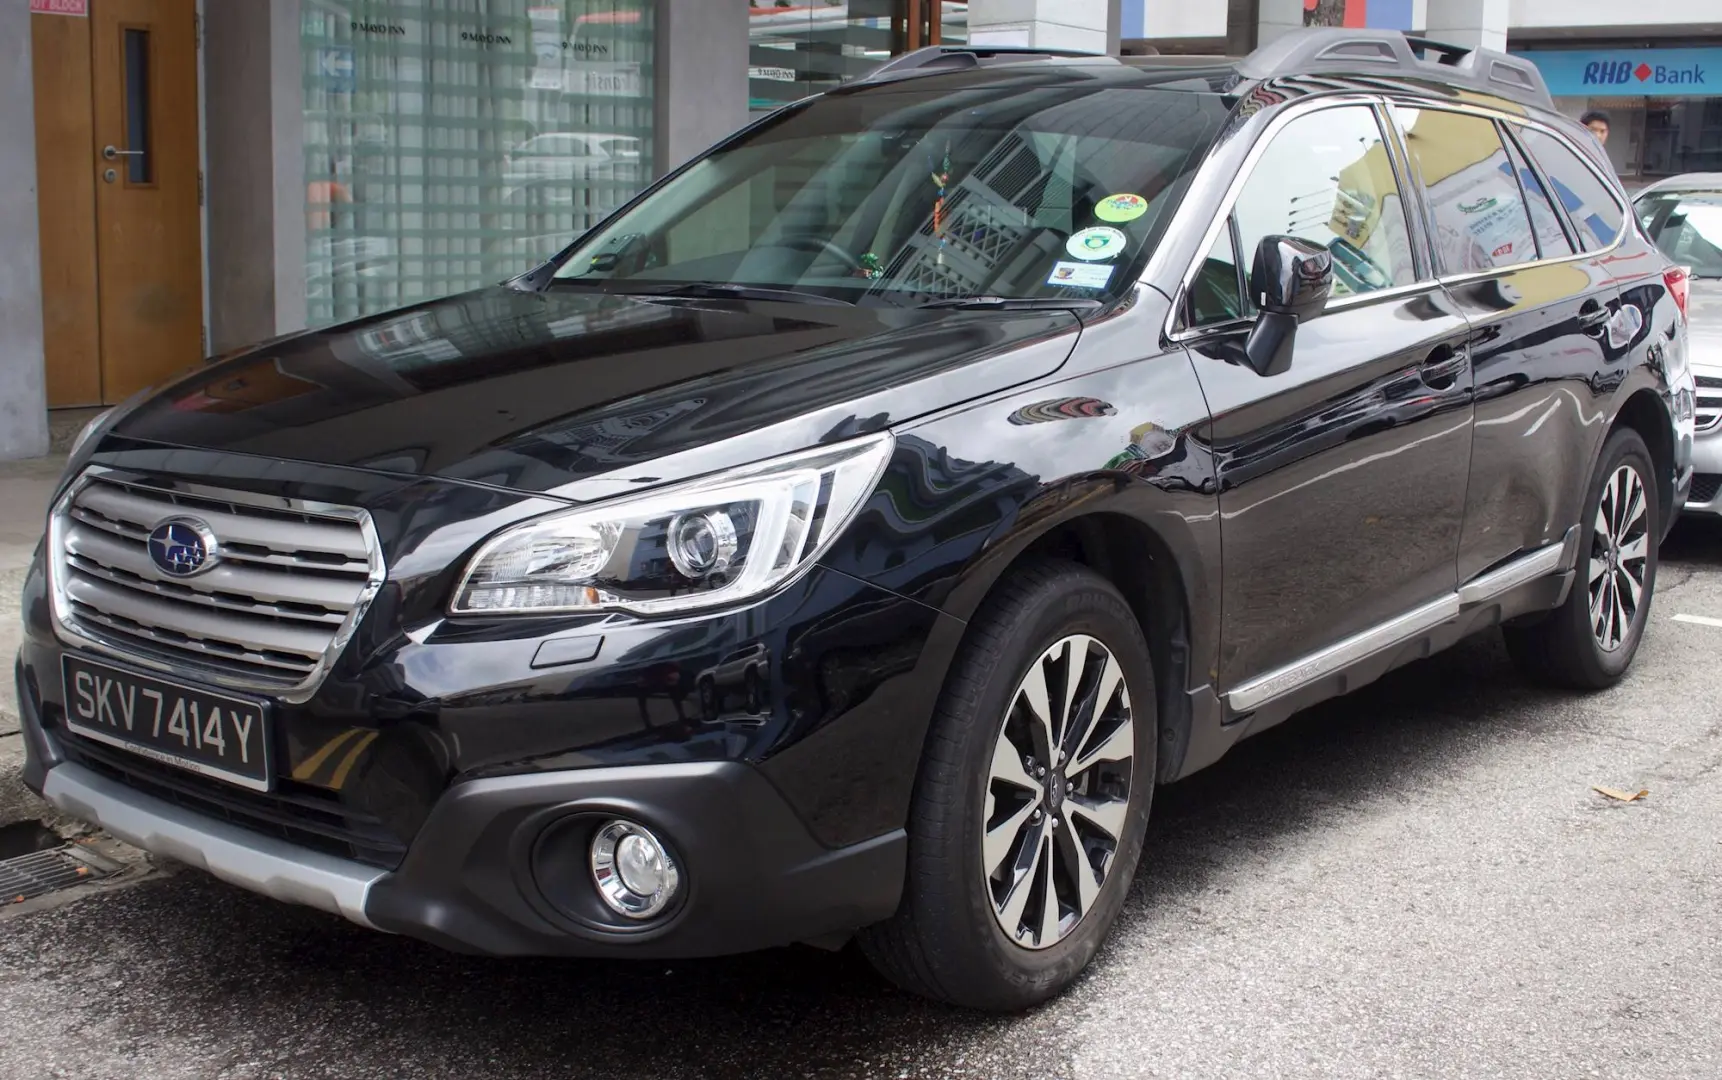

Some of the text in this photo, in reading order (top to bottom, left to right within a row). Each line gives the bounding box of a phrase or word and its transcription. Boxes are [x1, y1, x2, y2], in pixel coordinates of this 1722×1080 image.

[388, 25, 405, 36] INN
[496, 35, 512, 45] INN
[1582, 61, 1706, 85] RHB Bank
[75, 670, 253, 764] SKV 7414 Y
